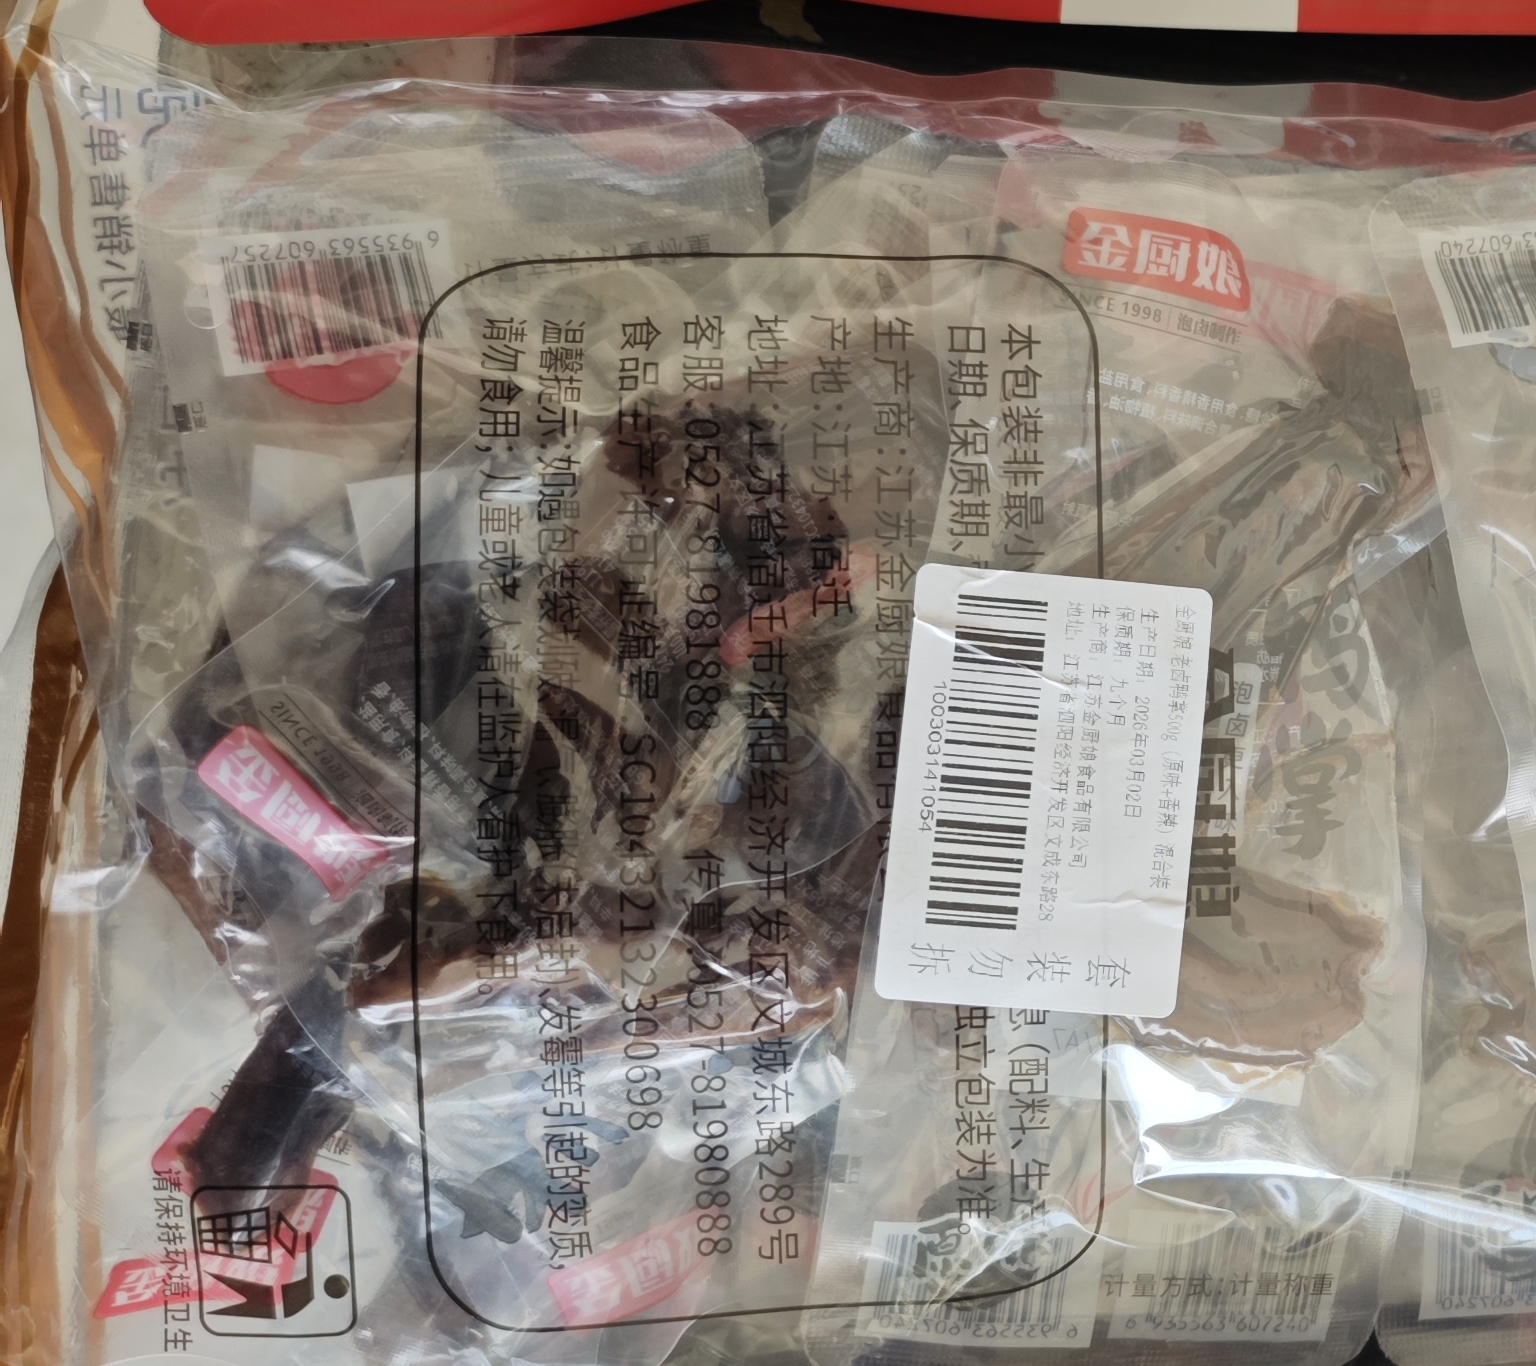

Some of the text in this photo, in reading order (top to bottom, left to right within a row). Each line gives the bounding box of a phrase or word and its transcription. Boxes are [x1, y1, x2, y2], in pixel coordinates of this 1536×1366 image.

[230, 231, 439, 263] 6 935563 607257
[1122, 301, 1162, 323] 1998
[918, 681, 947, 832] 100303141054
[154, 1168, 191, 1352] 请保持环境卫生
